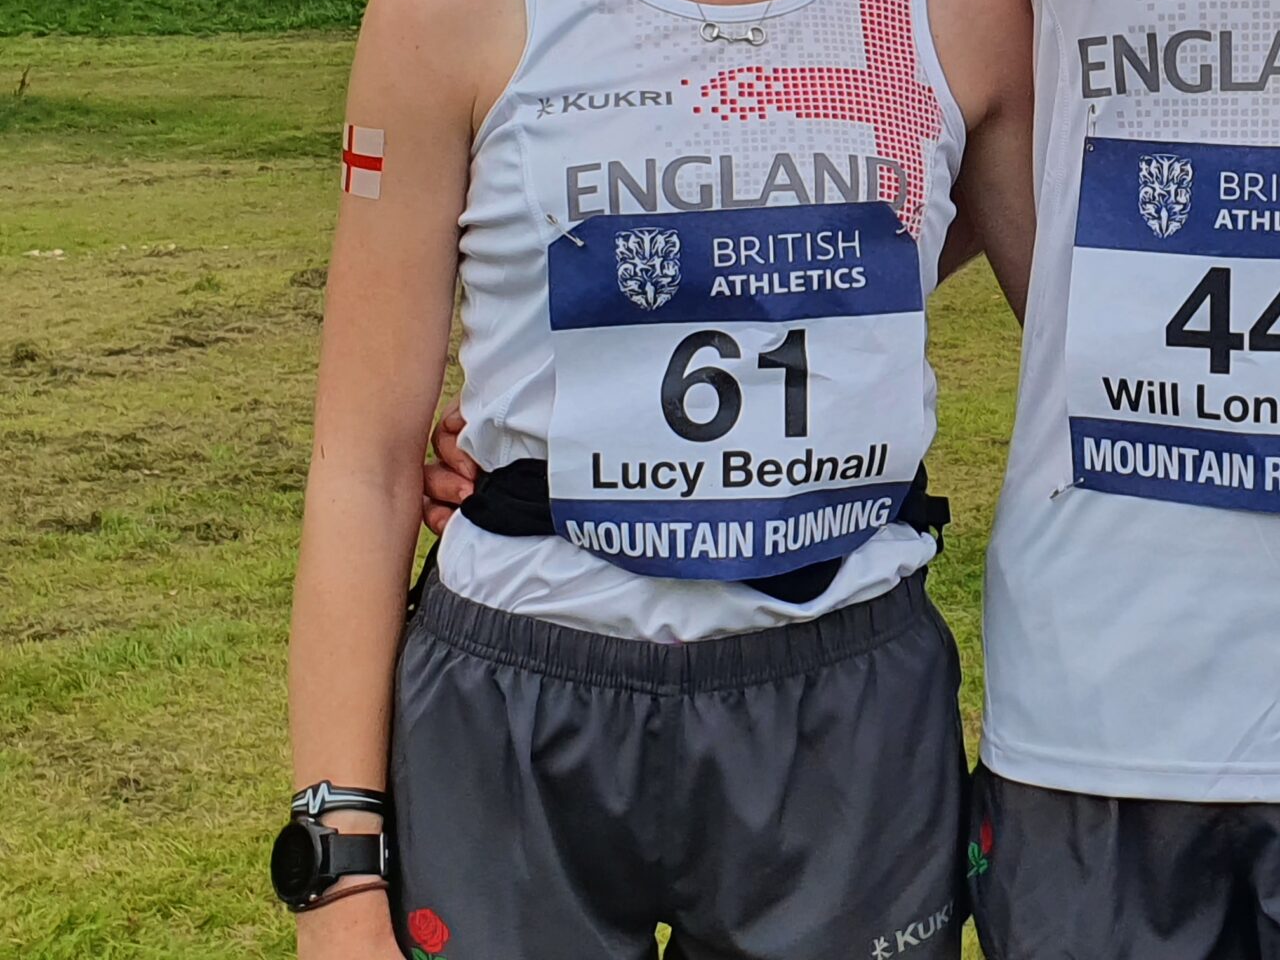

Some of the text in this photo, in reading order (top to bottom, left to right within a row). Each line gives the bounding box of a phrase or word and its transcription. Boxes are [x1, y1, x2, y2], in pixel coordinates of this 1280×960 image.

[560, 90, 674, 114] KUKRI
[566, 152, 907, 222] ENGLAND
[712, 230, 862, 268] BRITISH
[709, 266, 867, 298] ATHLETICS
[660, 328, 809, 443] 61
[1102, 376, 1180, 416] Will
[592, 443, 888, 498] Lucy Bednall
[1082, 436, 1255, 490] MOUNTAIN
[566, 496, 893, 559] MOUNTAIN RUNNING
[895, 901, 953, 953] KUK
